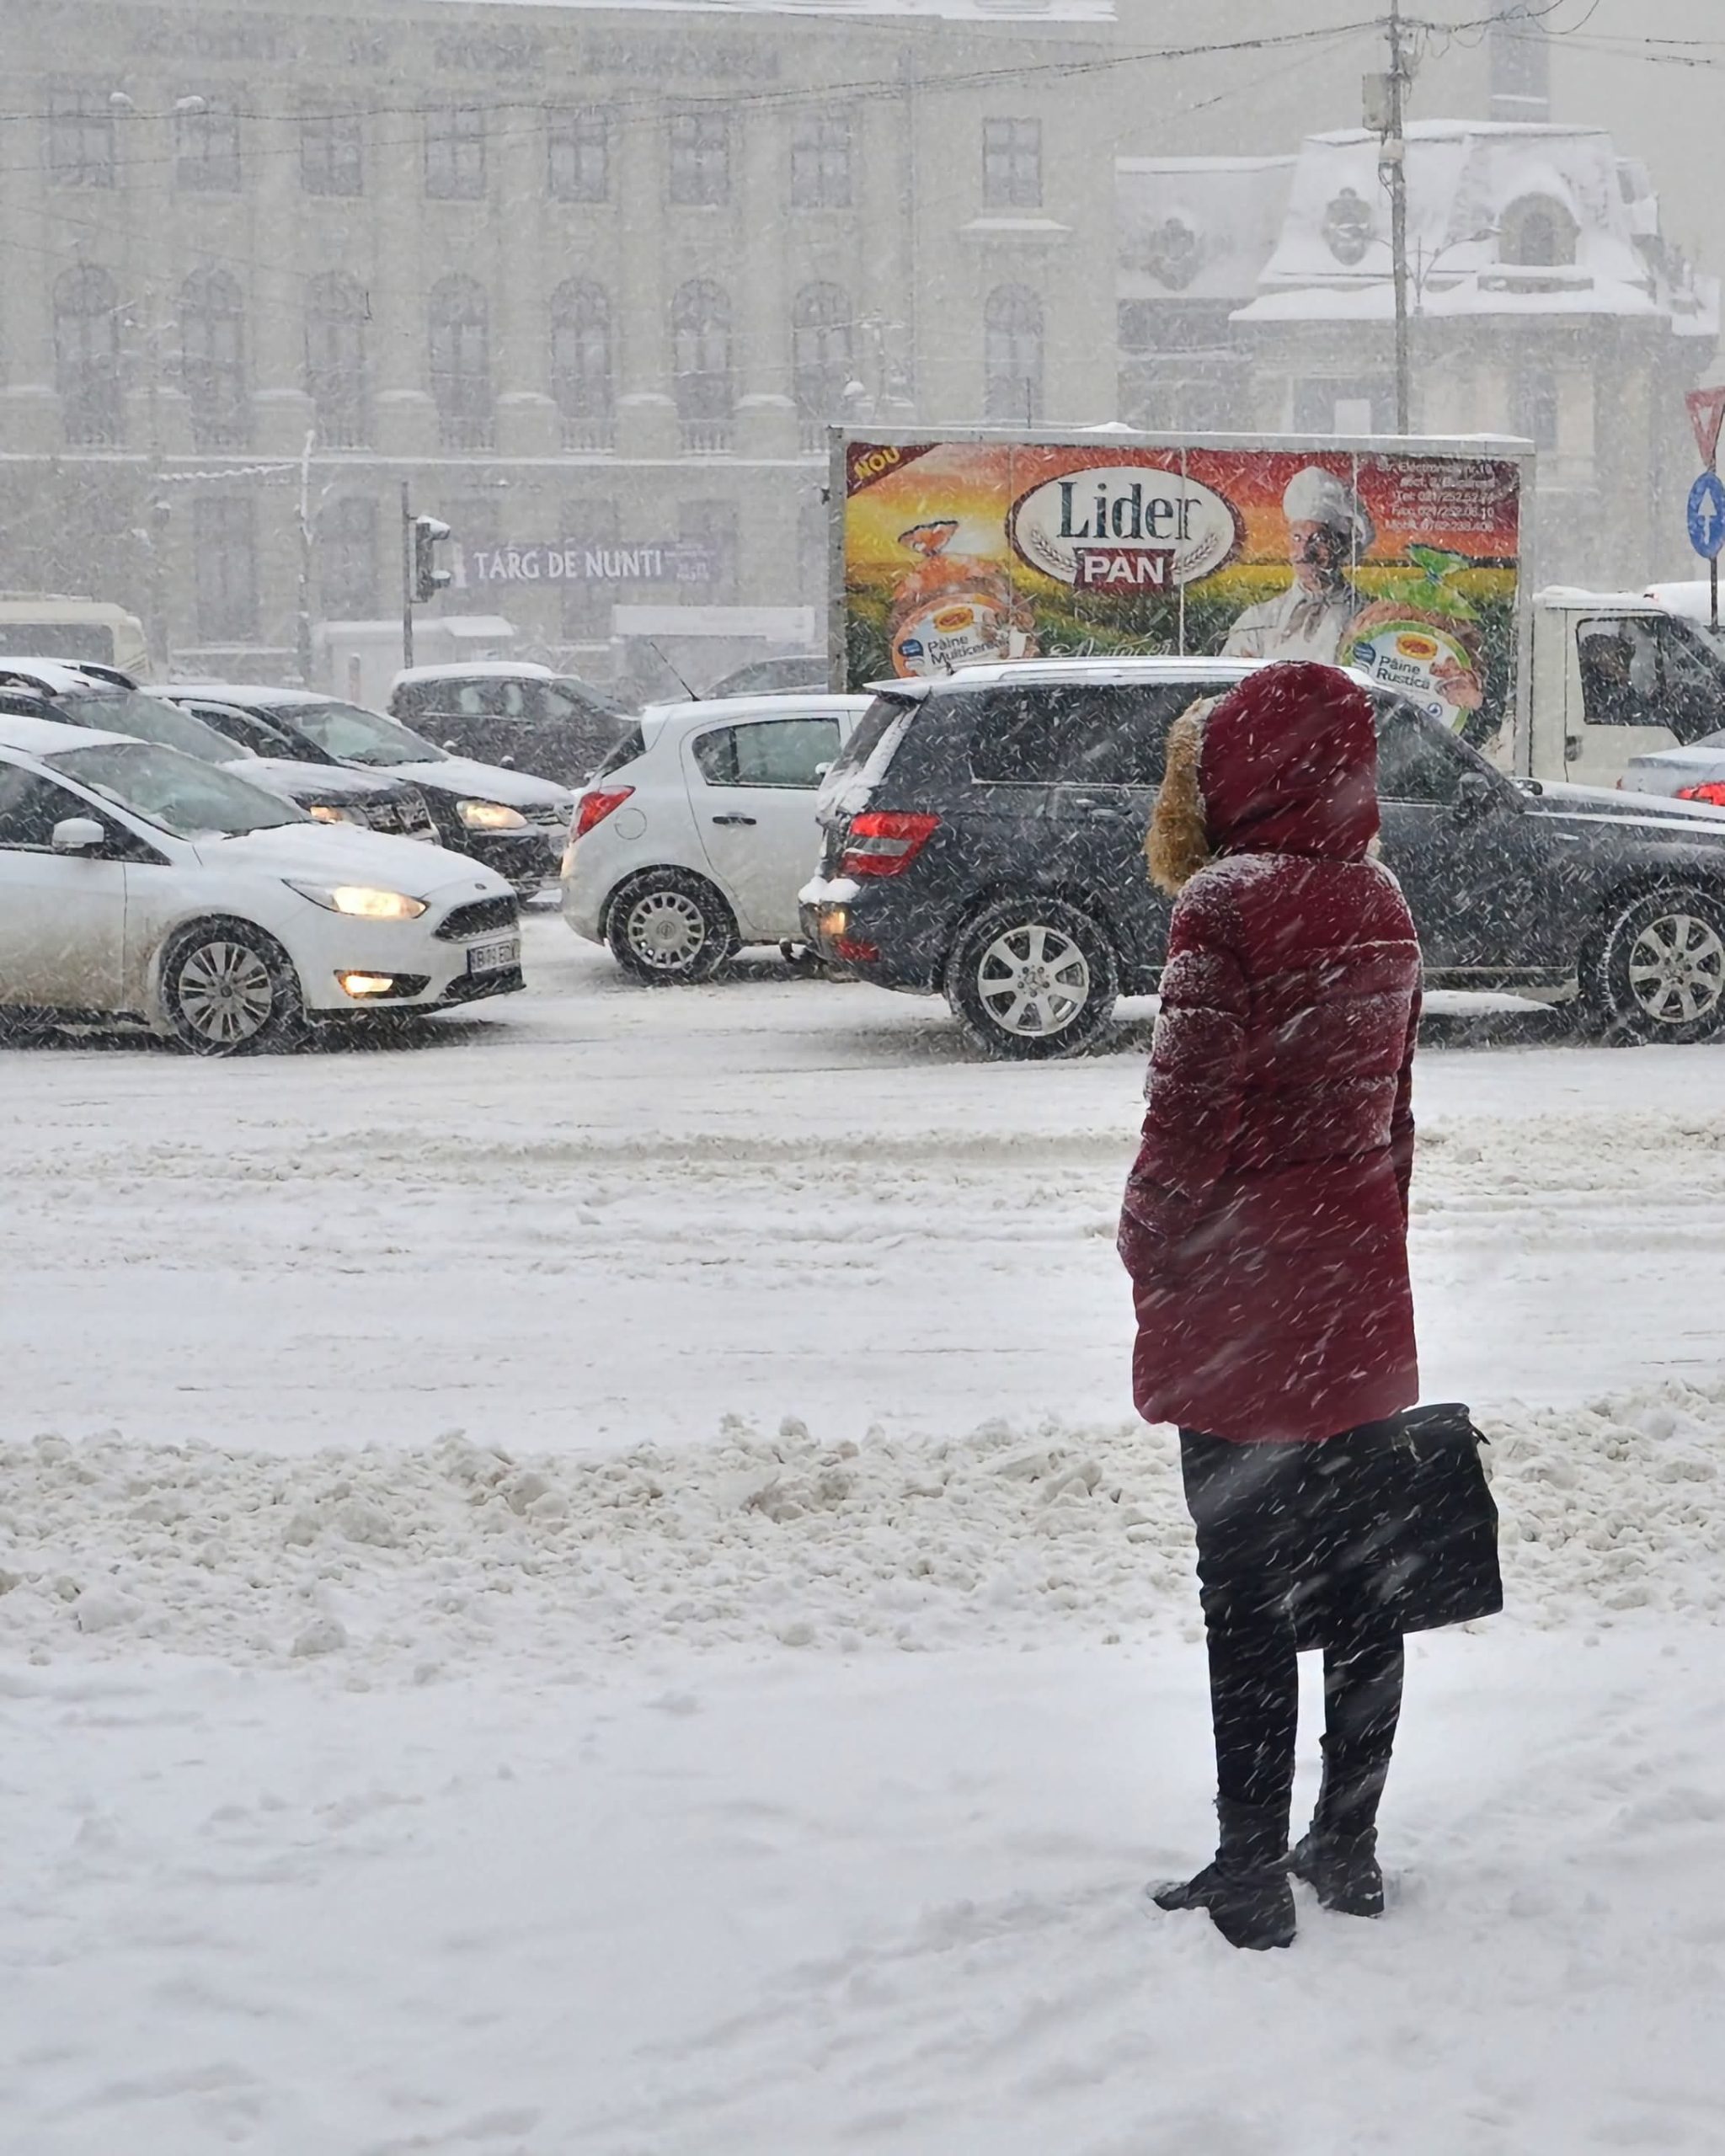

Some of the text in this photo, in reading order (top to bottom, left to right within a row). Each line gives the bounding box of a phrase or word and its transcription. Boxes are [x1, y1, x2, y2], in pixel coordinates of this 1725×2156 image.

[854, 446, 900, 480] NOU
[1056, 482, 1202, 540] Lider
[547, 551, 578, 579] DE
[1084, 556, 1164, 584] PAN
